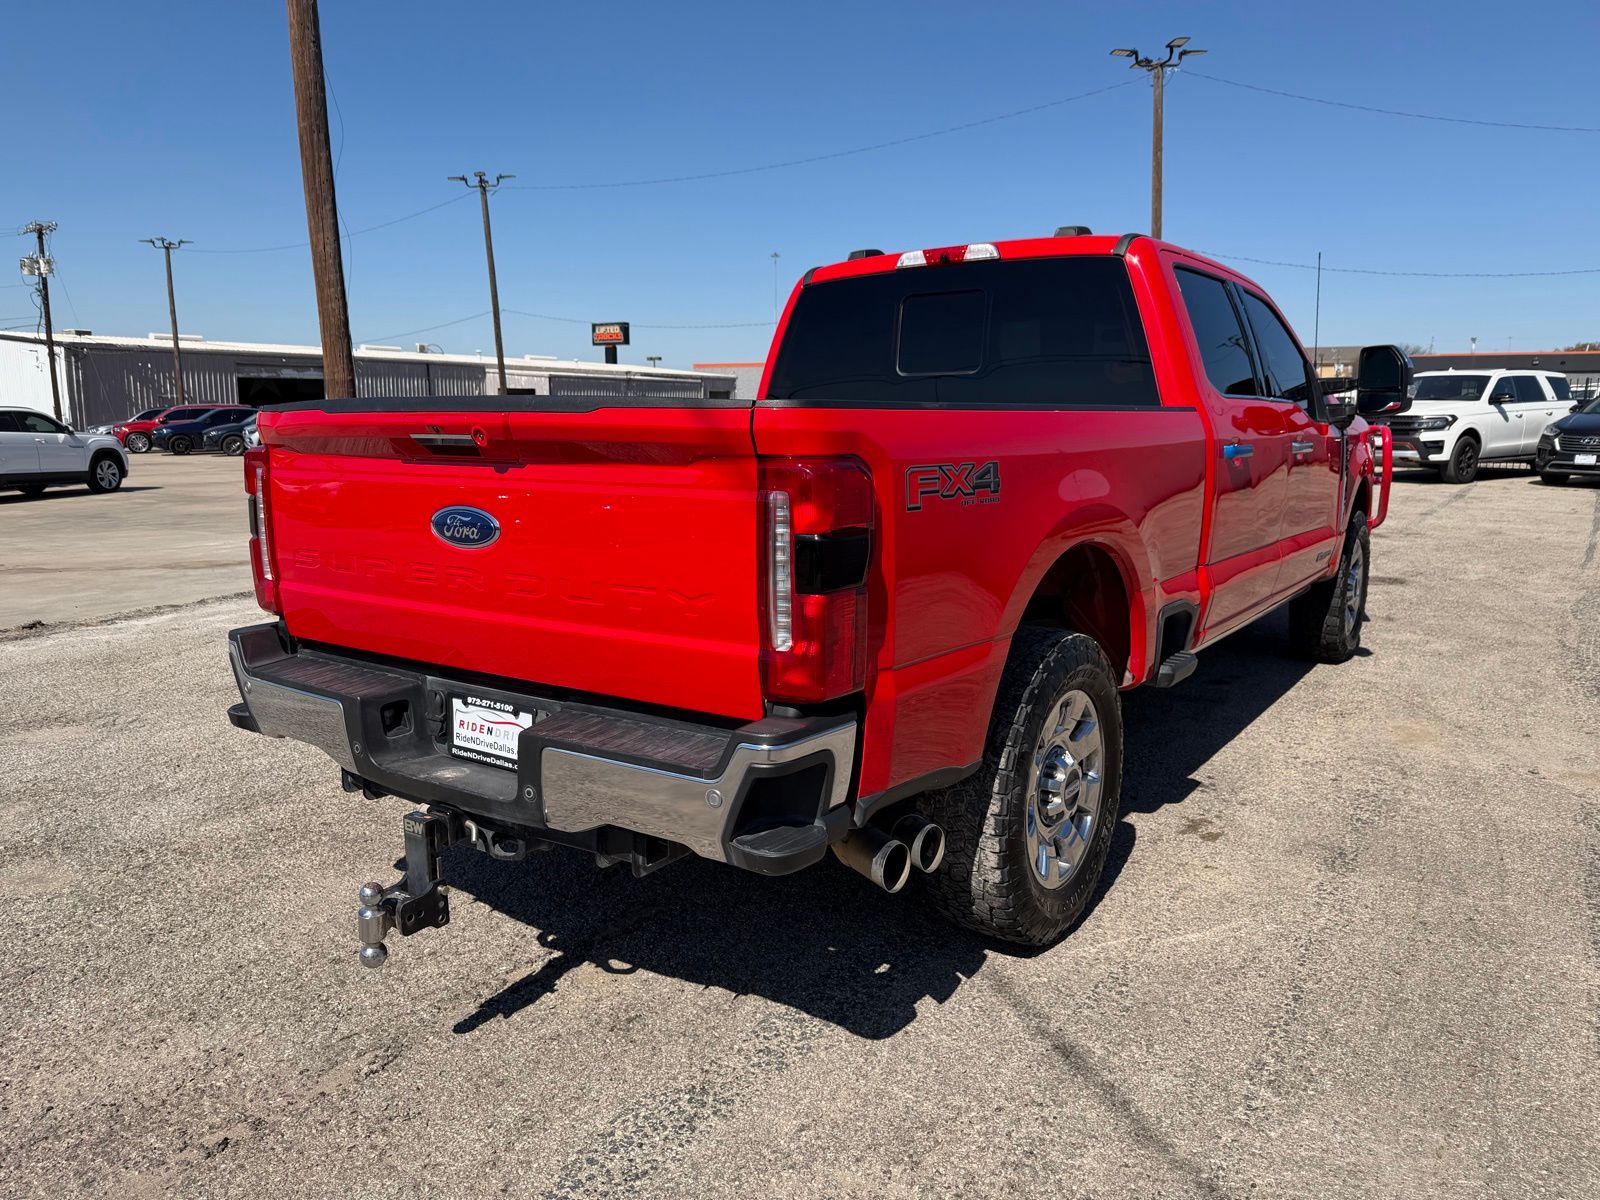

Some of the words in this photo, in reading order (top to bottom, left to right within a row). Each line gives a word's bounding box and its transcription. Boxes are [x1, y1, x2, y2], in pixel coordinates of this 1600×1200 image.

[905, 461, 1000, 512] FX4
[444, 514, 480, 539] Ford
[293, 546, 487, 592] SUPER
[504, 571, 718, 618] DUTY
[467, 696, 514, 712] 972-271-5100
[459, 719, 516, 741] RIDENDRI
[455, 732, 518, 756] RideNDriveDallas.
[452, 747, 519, 770] RideNDriveDallas.c
